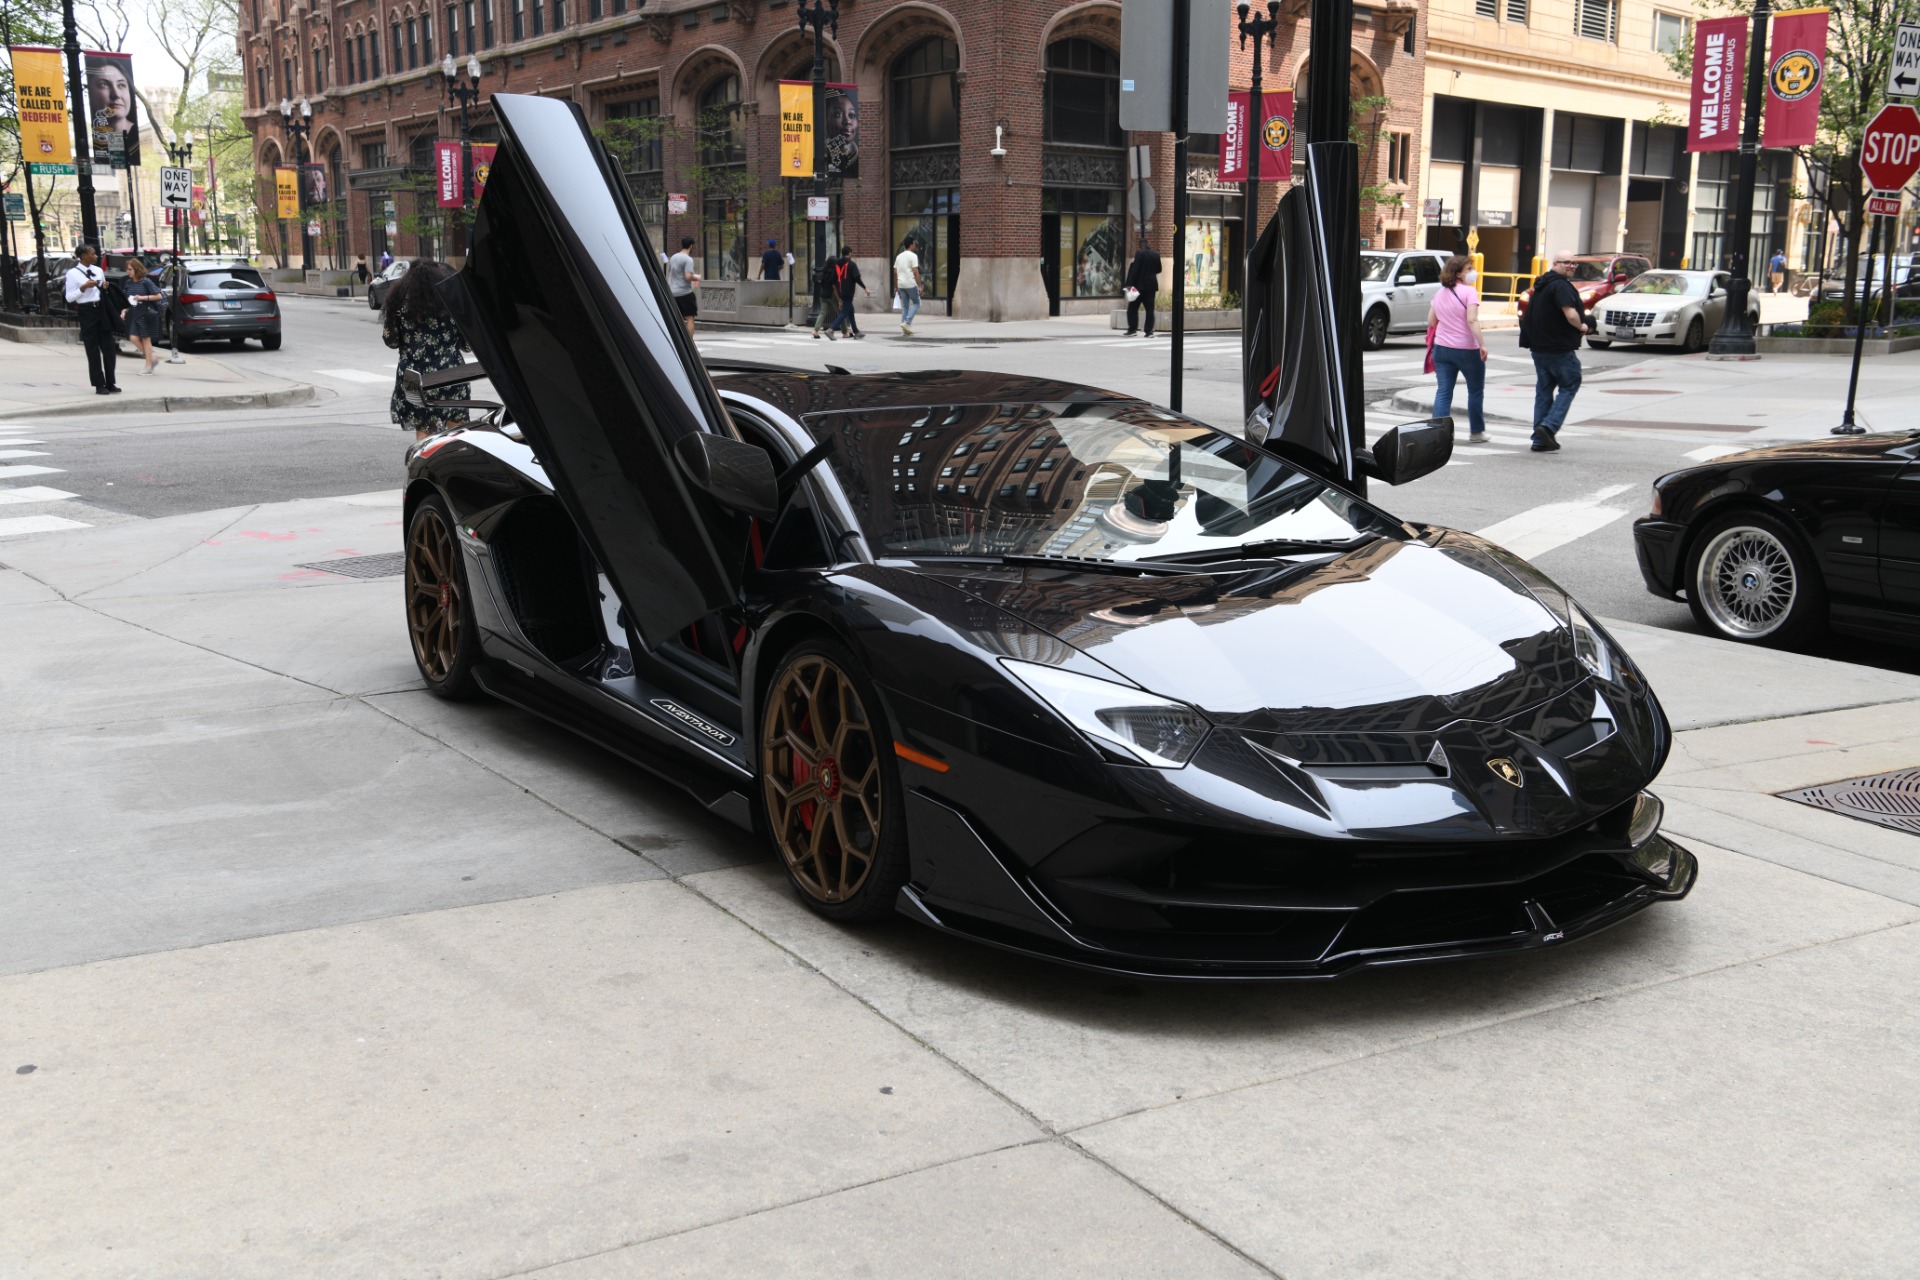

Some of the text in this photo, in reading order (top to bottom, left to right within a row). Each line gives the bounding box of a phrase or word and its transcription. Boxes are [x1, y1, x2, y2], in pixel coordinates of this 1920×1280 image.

[1896, 50, 1920, 68] WAY
[1699, 33, 1725, 139] WELCOME
[1721, 38, 1736, 131] WATER TOWER CAMPUS
[19, 85, 51, 97] WE ARE
[20, 98, 64, 110] CALLED TO
[21, 111, 62, 123] REDEFINE
[783, 112, 803, 121] WE ARE
[783, 123, 811, 132] CALLED TO
[783, 133, 801, 143] SOLVE
[1224, 101, 1238, 174] WELCOME
[1865, 131, 1920, 166] STOP
[40, 165, 64, 174] RUSH
[441, 148, 453, 201] WELCOME
[164, 170, 188, 182] ONE
[164, 181, 188, 193] WAY
[1871, 200, 1900, 212] ALL WAY
[661, 704, 728, 740] AVENTADOR
